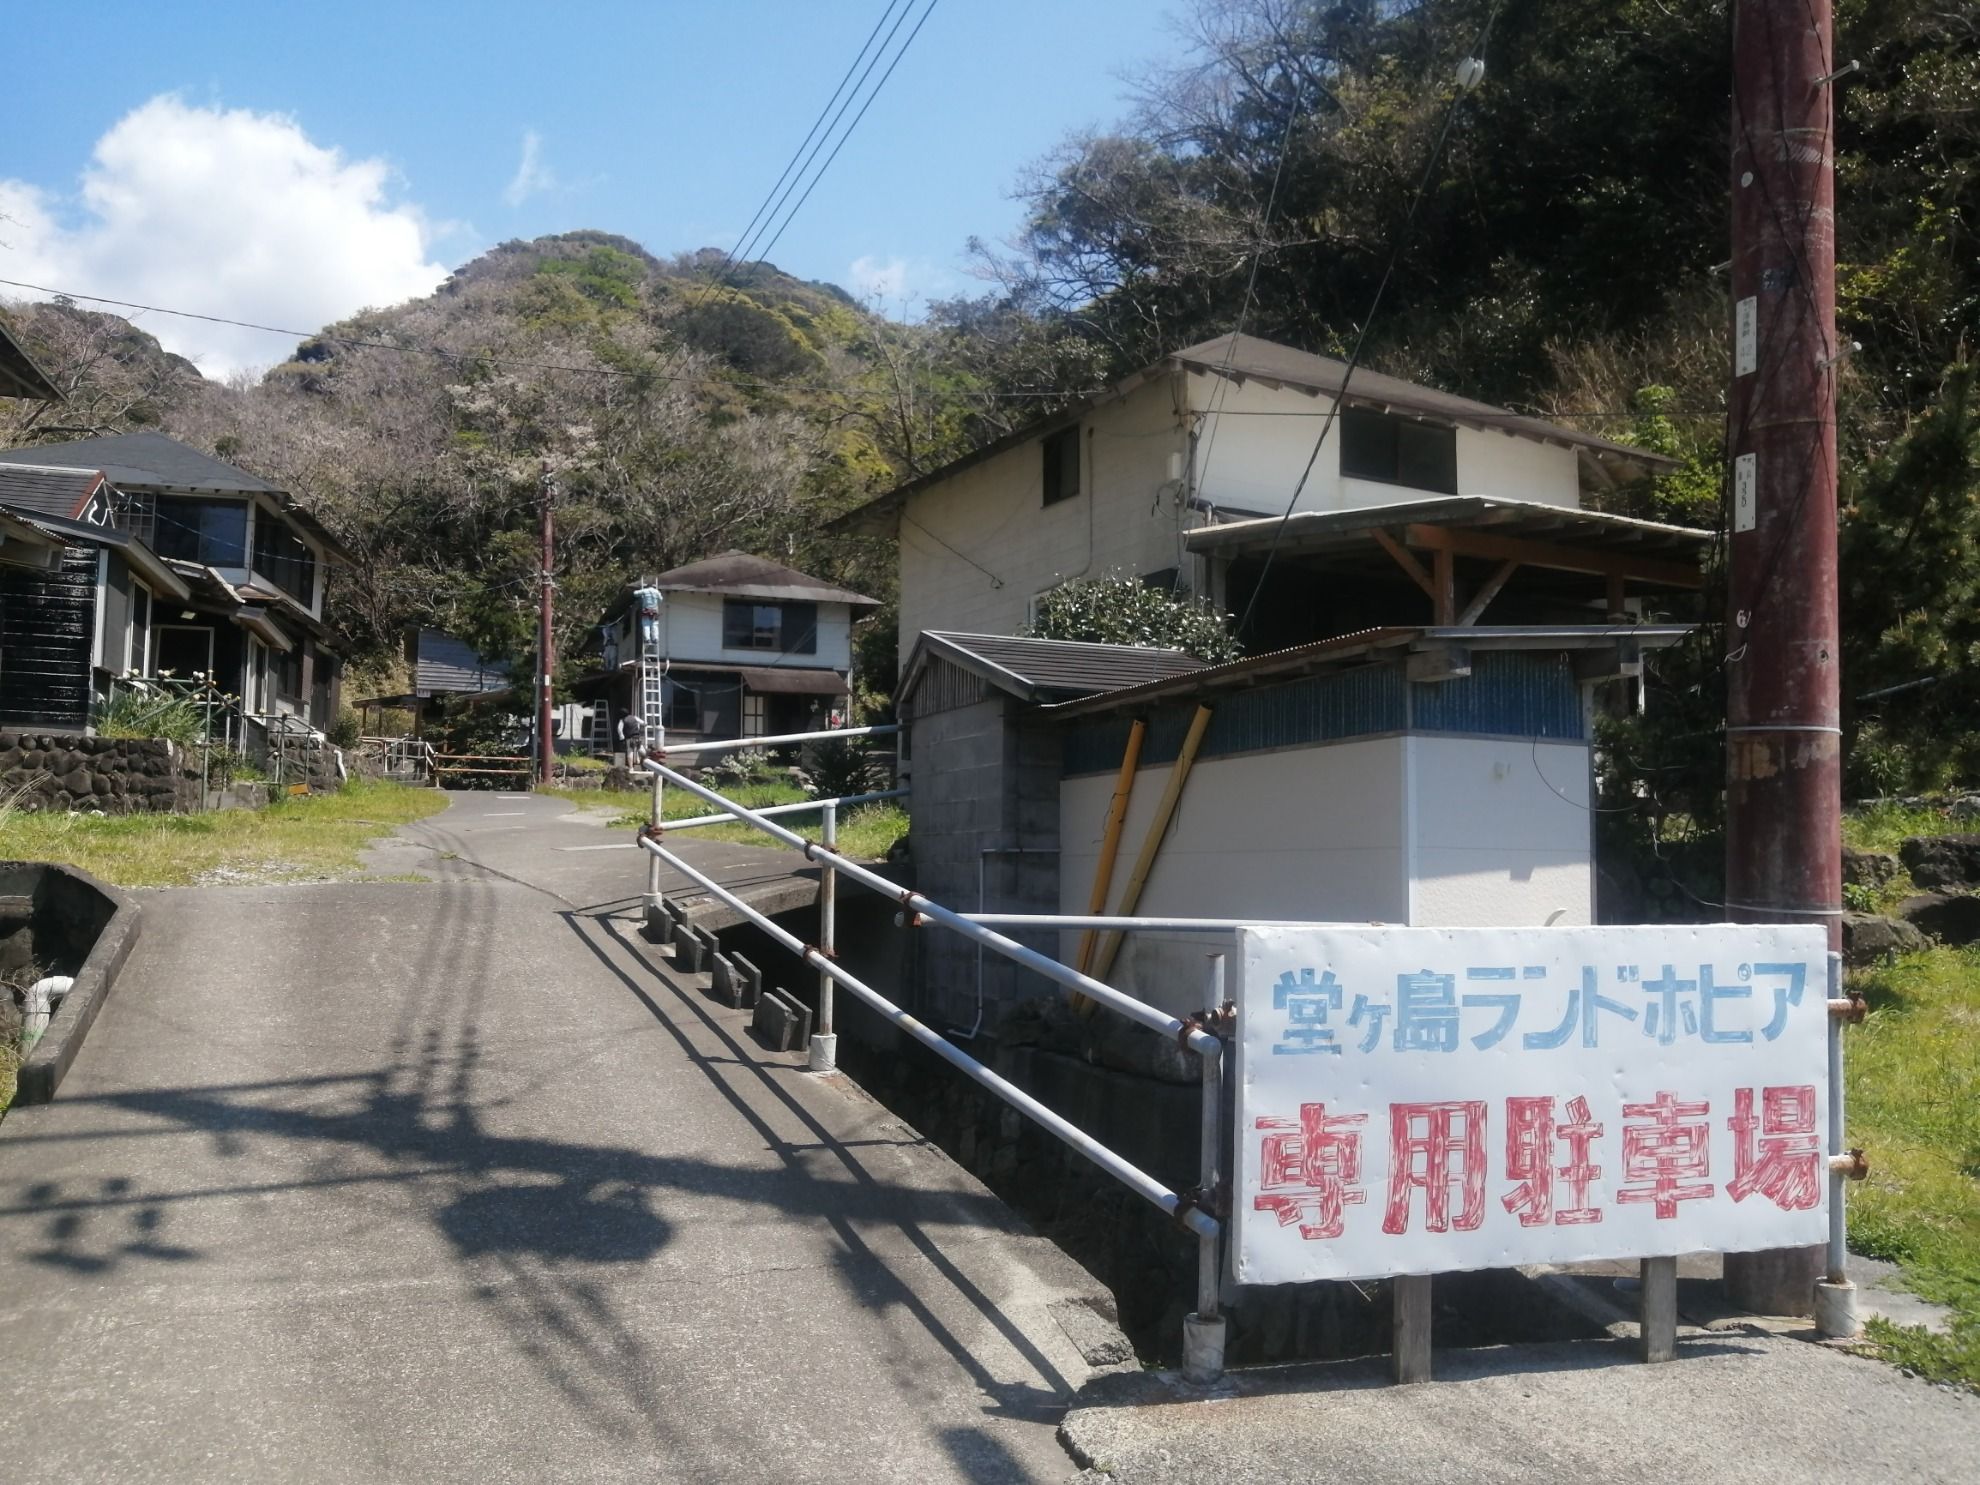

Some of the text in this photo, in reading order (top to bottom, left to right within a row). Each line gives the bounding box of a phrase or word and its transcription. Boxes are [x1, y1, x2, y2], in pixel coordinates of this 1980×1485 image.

[1254, 1085, 1821, 1240] 専用駐車場
